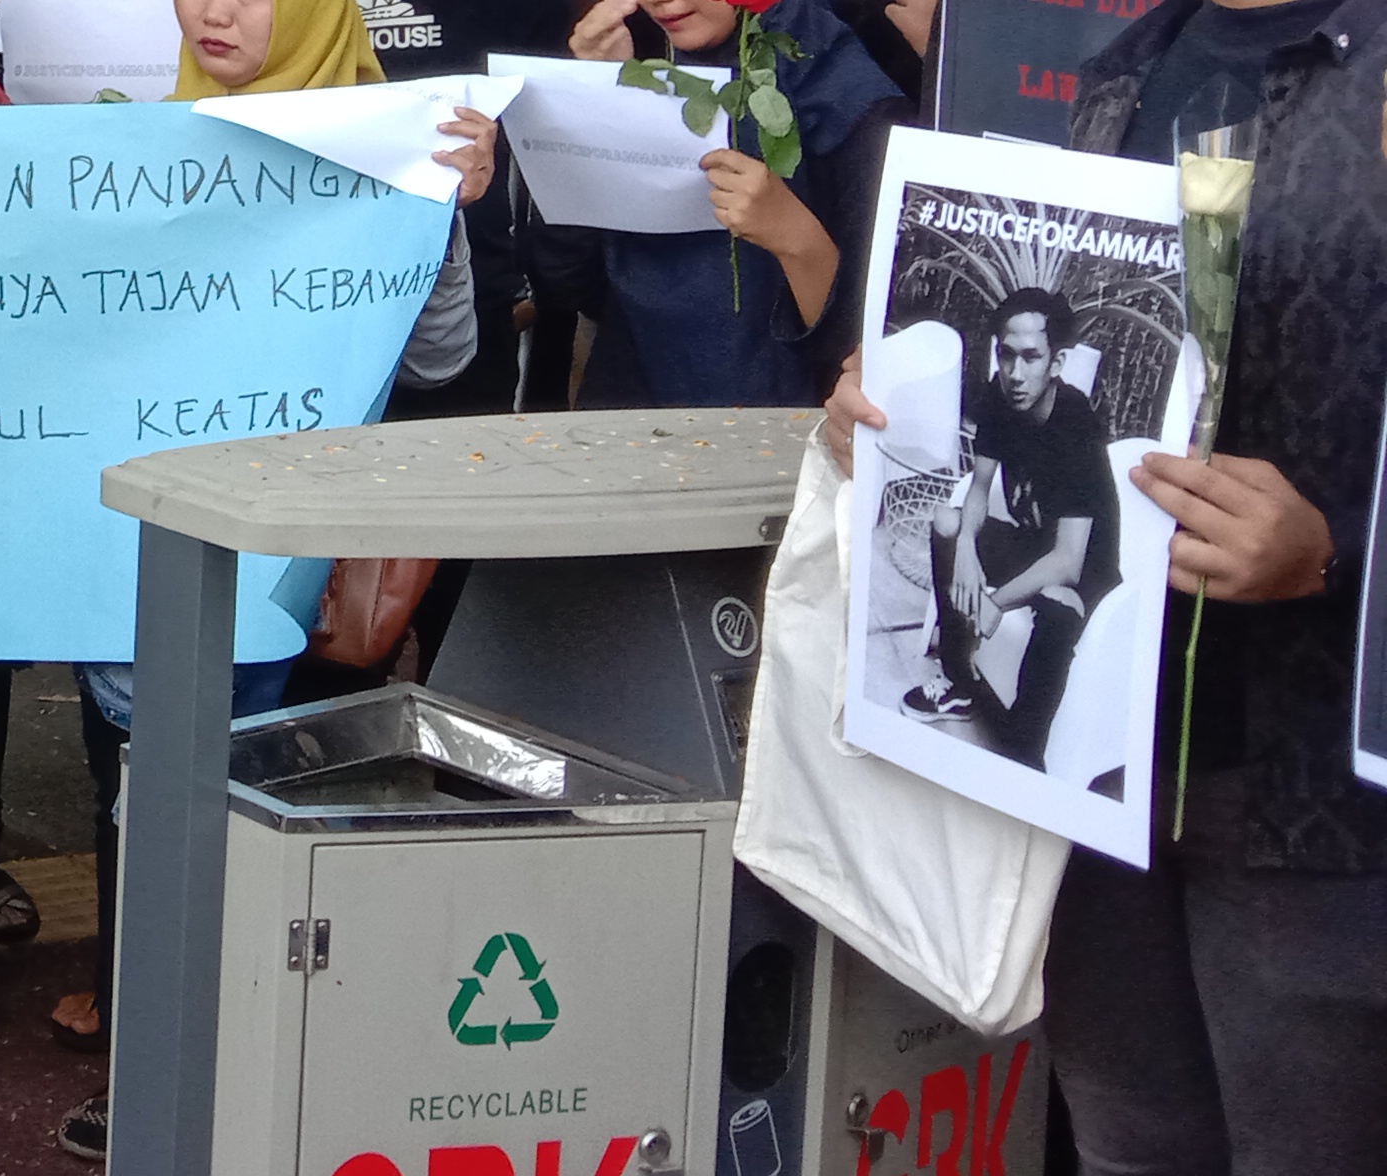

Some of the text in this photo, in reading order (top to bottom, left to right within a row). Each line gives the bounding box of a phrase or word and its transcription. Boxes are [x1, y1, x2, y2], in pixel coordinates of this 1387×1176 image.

[68, 153, 405, 212] PANDANGA
[918, 199, 1181, 272] #JUSTICEFORAMMAR
[81, 269, 241, 314] TAJAM
[136, 386, 325, 441] KEATAS
[409, 1088, 588, 1122] RECYCLABLE
